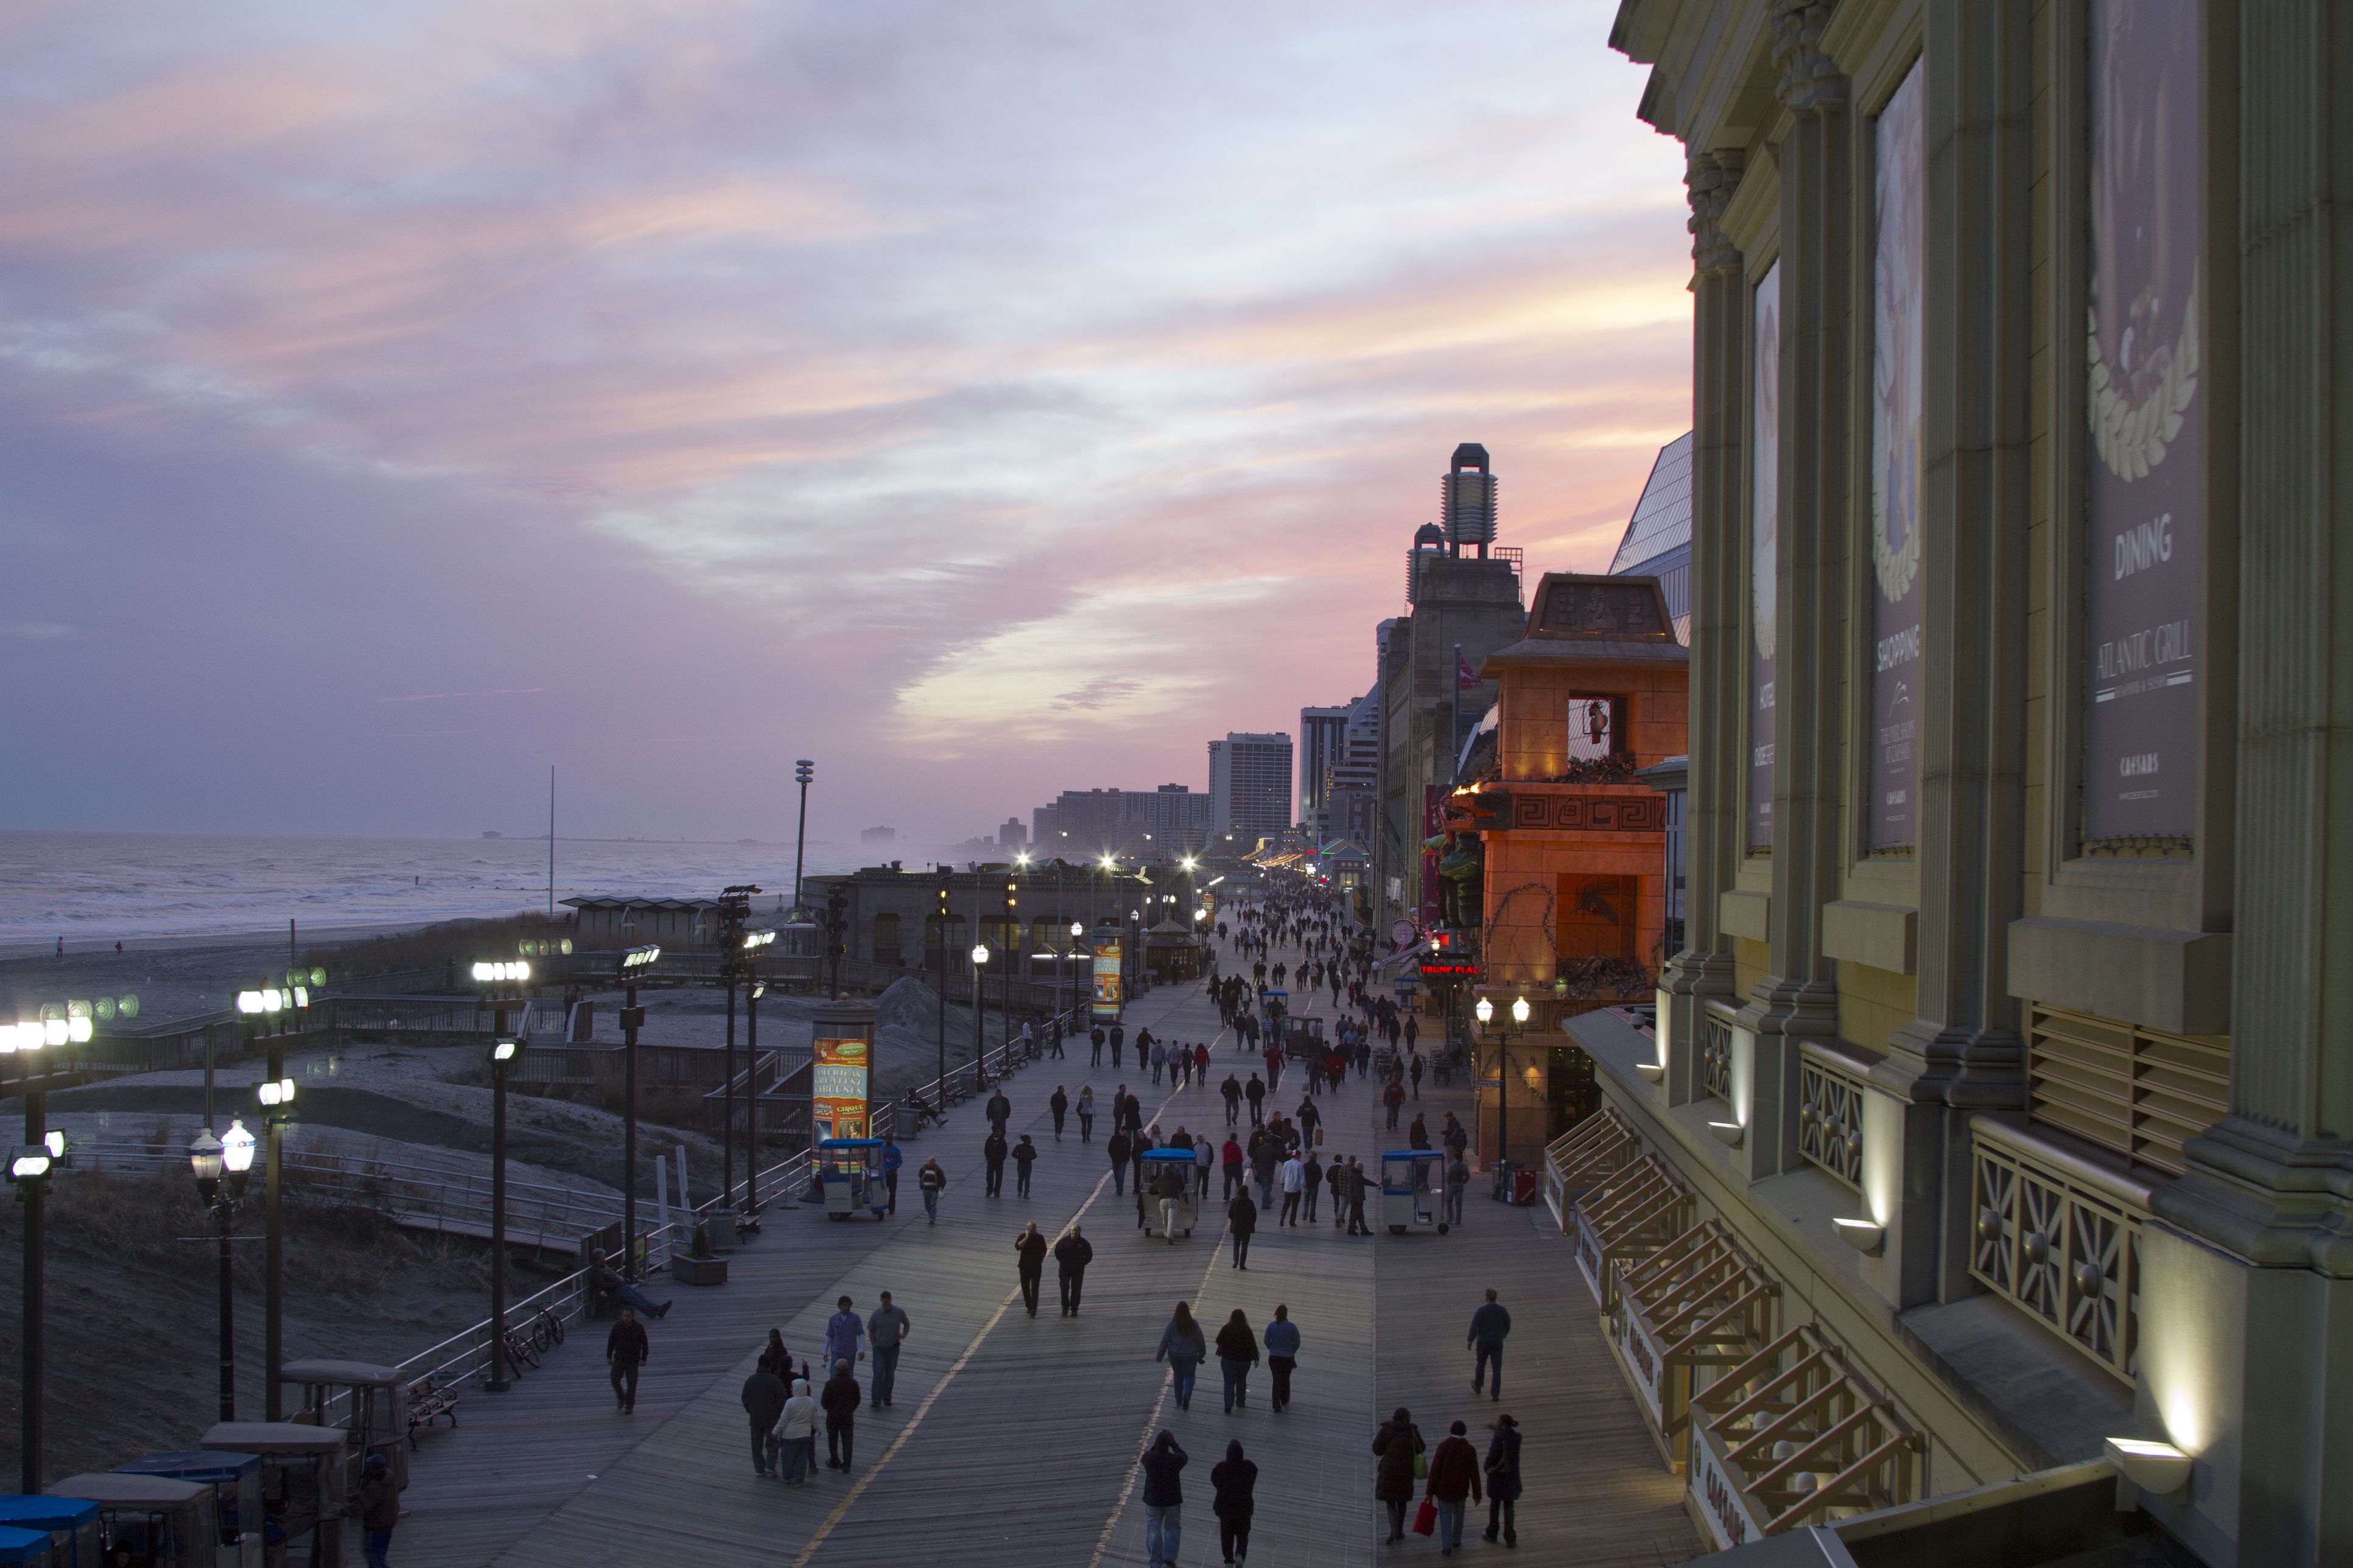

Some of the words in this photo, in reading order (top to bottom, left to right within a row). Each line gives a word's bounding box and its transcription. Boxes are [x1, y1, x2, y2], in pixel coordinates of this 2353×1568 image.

[2114, 513, 2172, 581] DINING
[1877, 623, 1920, 673] SHOPPING
[2095, 629, 2152, 681] ATLANTIC
[2154, 619, 2193, 664] GRILL
[1759, 681, 1775, 710] HOTEL
[2119, 751, 2159, 777] CAESARS
[1421, 965, 1453, 974] TRUMP
[1454, 965, 1481, 975] PLAZ
[815, 1077, 862, 1086] GREATEST
[815, 1085, 863, 1095] CIRCUSES
[836, 1104, 863, 1113] CIRQUE
[1706, 1462, 1745, 1547] CAESARS
